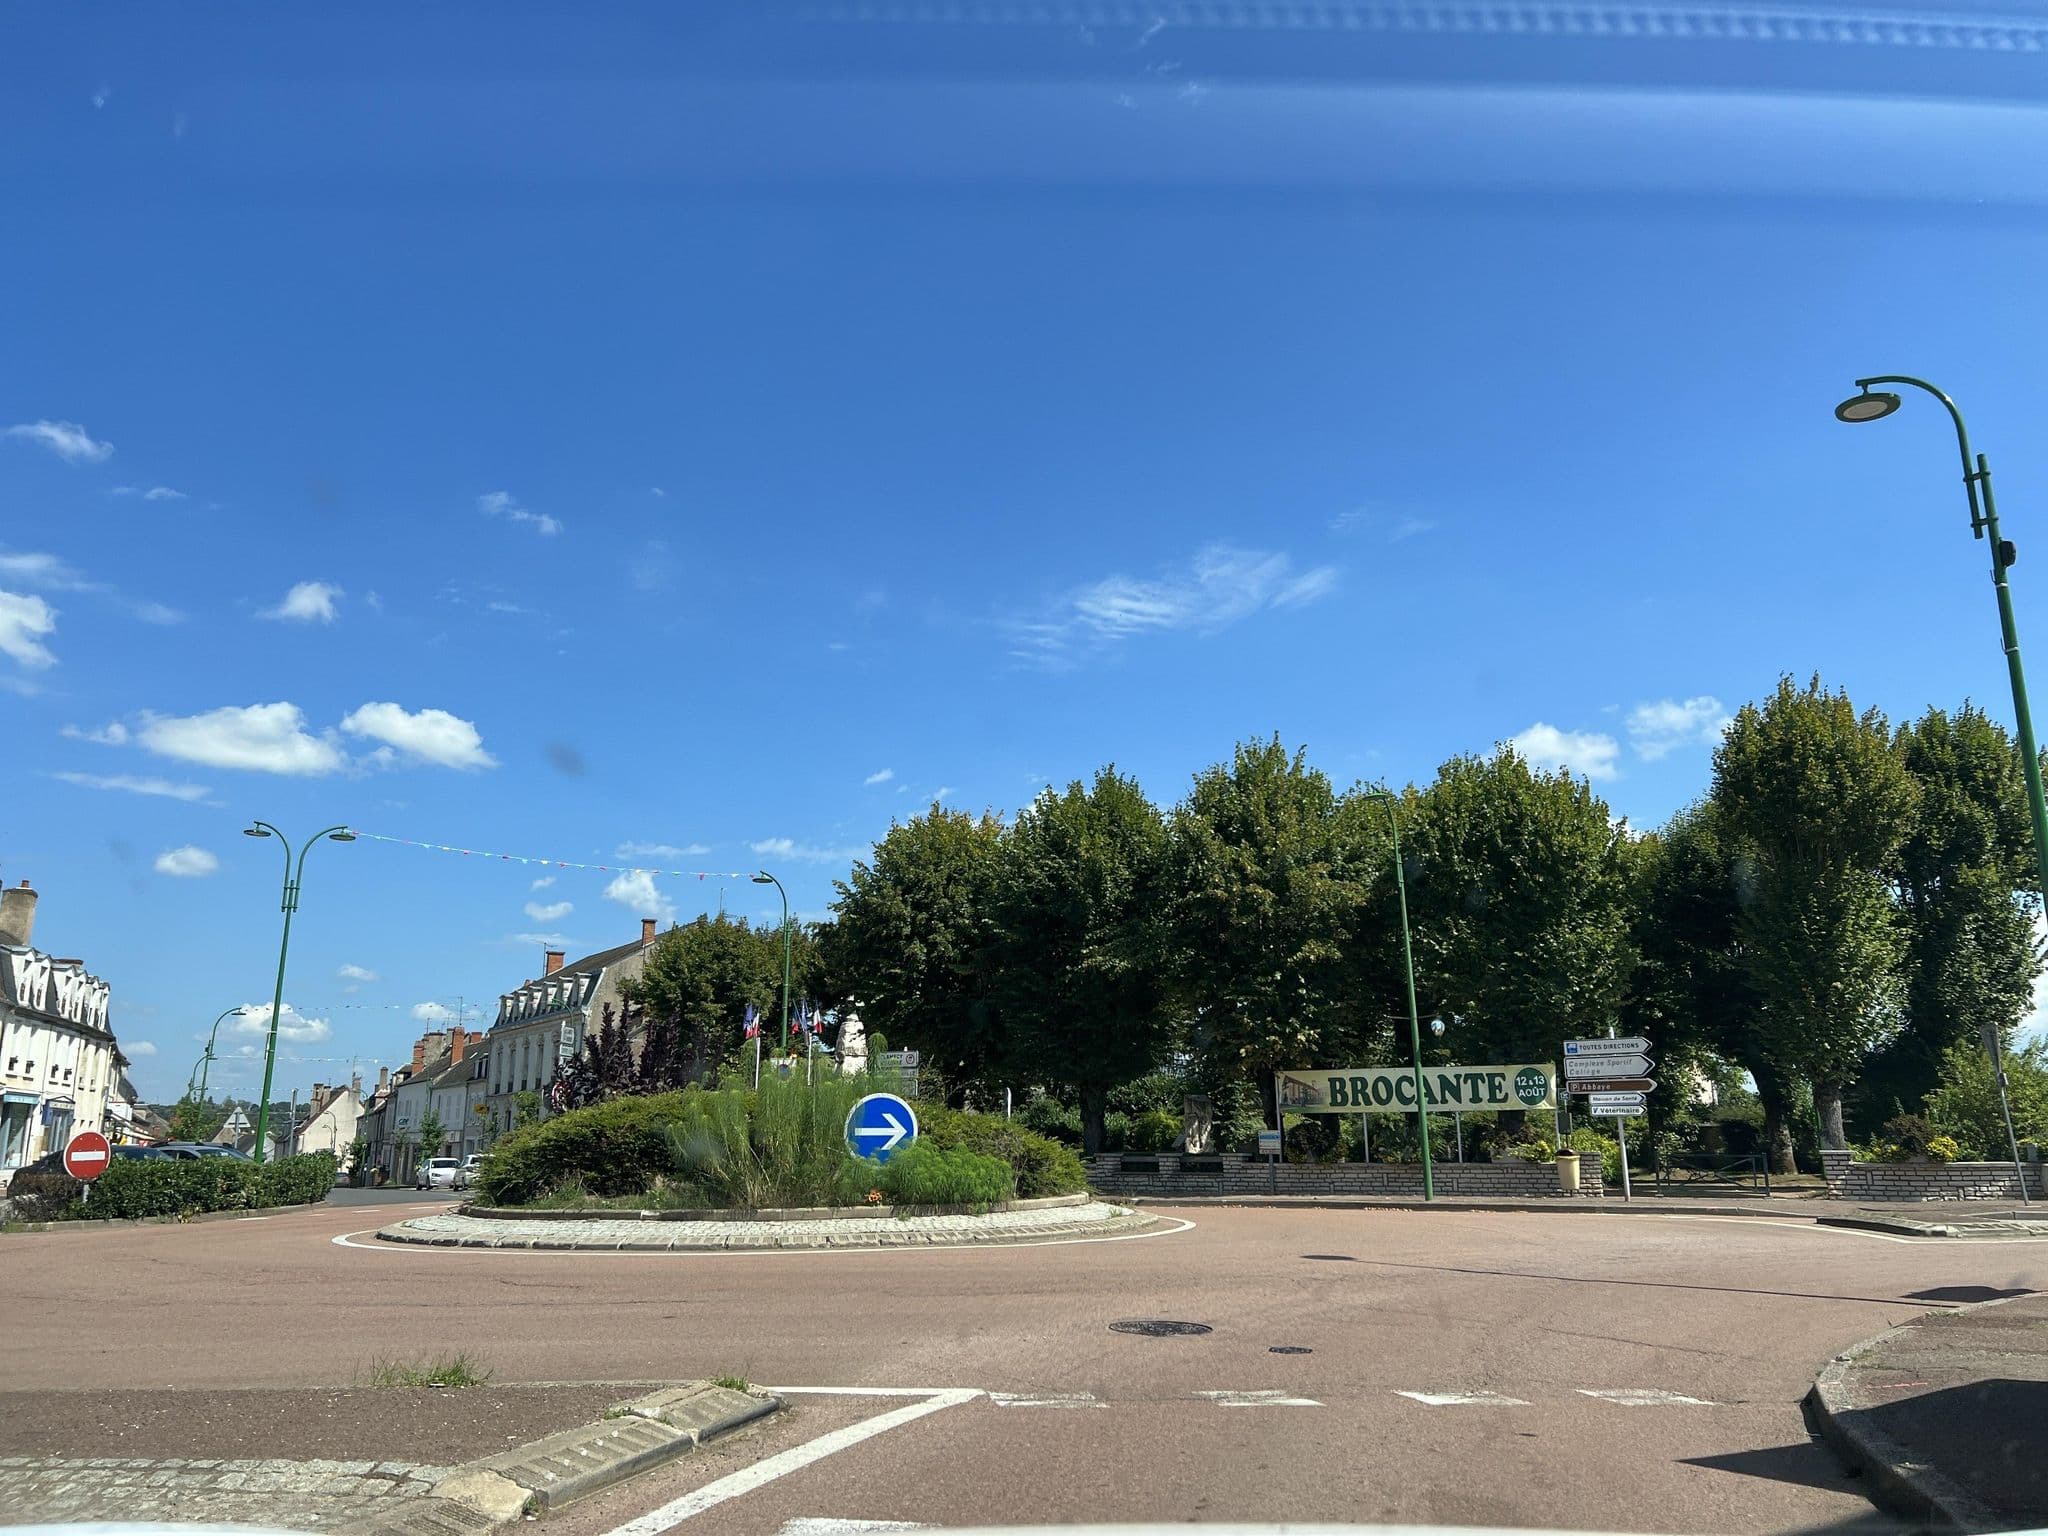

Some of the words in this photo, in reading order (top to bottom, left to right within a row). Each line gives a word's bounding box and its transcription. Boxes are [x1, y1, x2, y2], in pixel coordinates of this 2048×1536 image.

[1603, 1042, 1639, 1050] DIRECTIONS
[1568, 1059, 1604, 1068] Complexe
[1607, 1058, 1632, 1067] Sportif
[1516, 1076, 1527, 1086] 12
[1533, 1075, 1545, 1085] 13
[1328, 1073, 1509, 1107] BROCANTE
[1519, 1086, 1545, 1097] AOÛT
[1581, 1083, 1611, 1091] Abbaye
